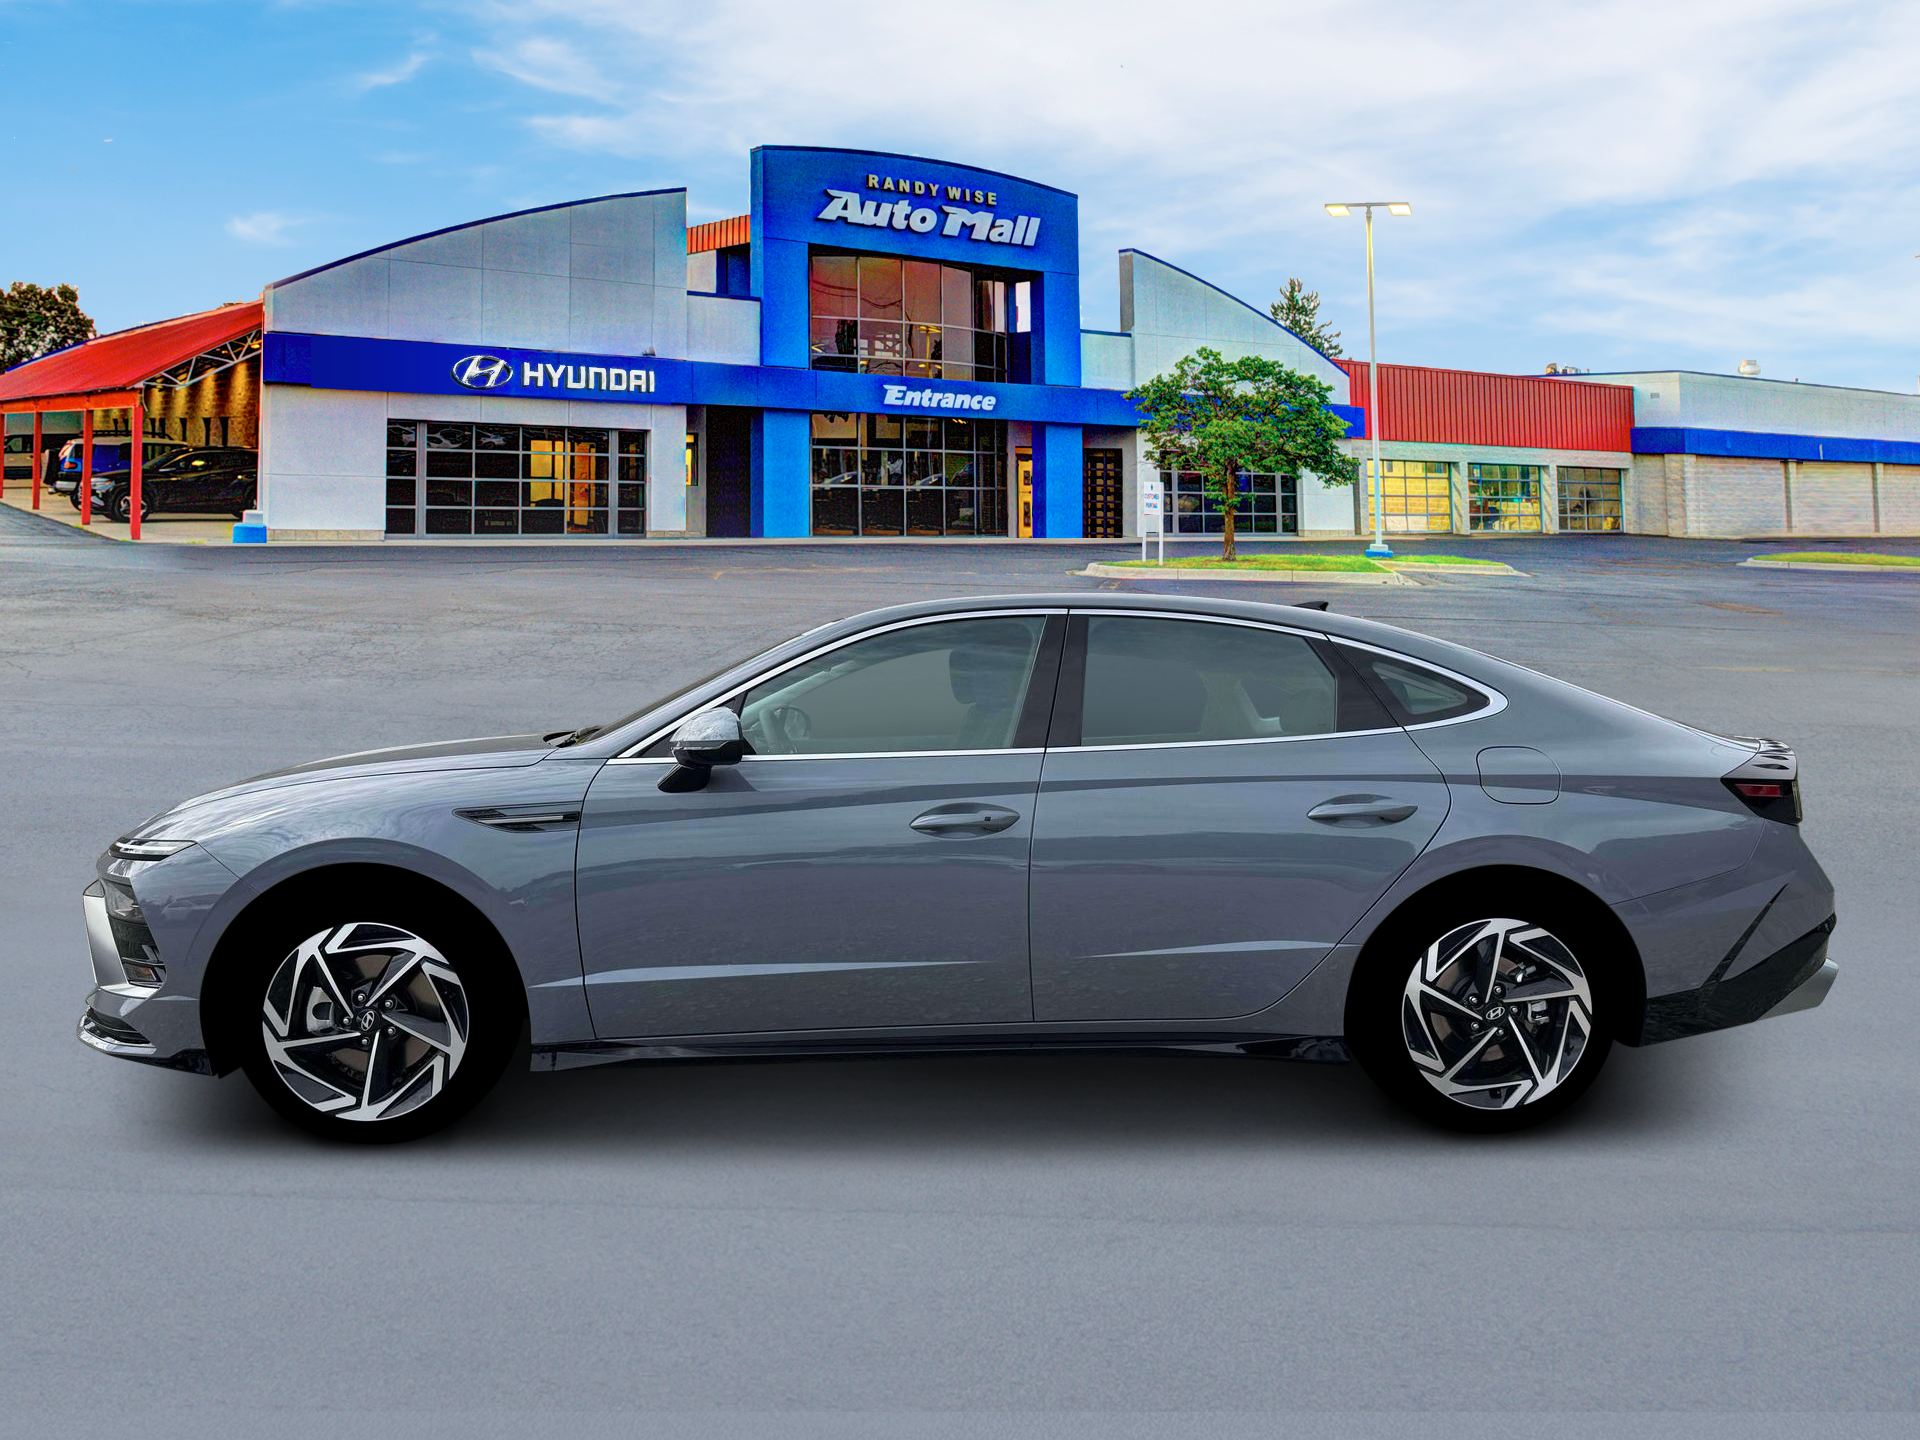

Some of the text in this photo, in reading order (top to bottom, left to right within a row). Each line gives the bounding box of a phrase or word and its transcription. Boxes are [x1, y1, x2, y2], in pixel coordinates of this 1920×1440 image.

[867, 173, 998, 206] RANDY WISE
[817, 188, 1041, 247] Auto Mall
[522, 361, 655, 394] HYUNDAI
[883, 384, 997, 411] Entrance
